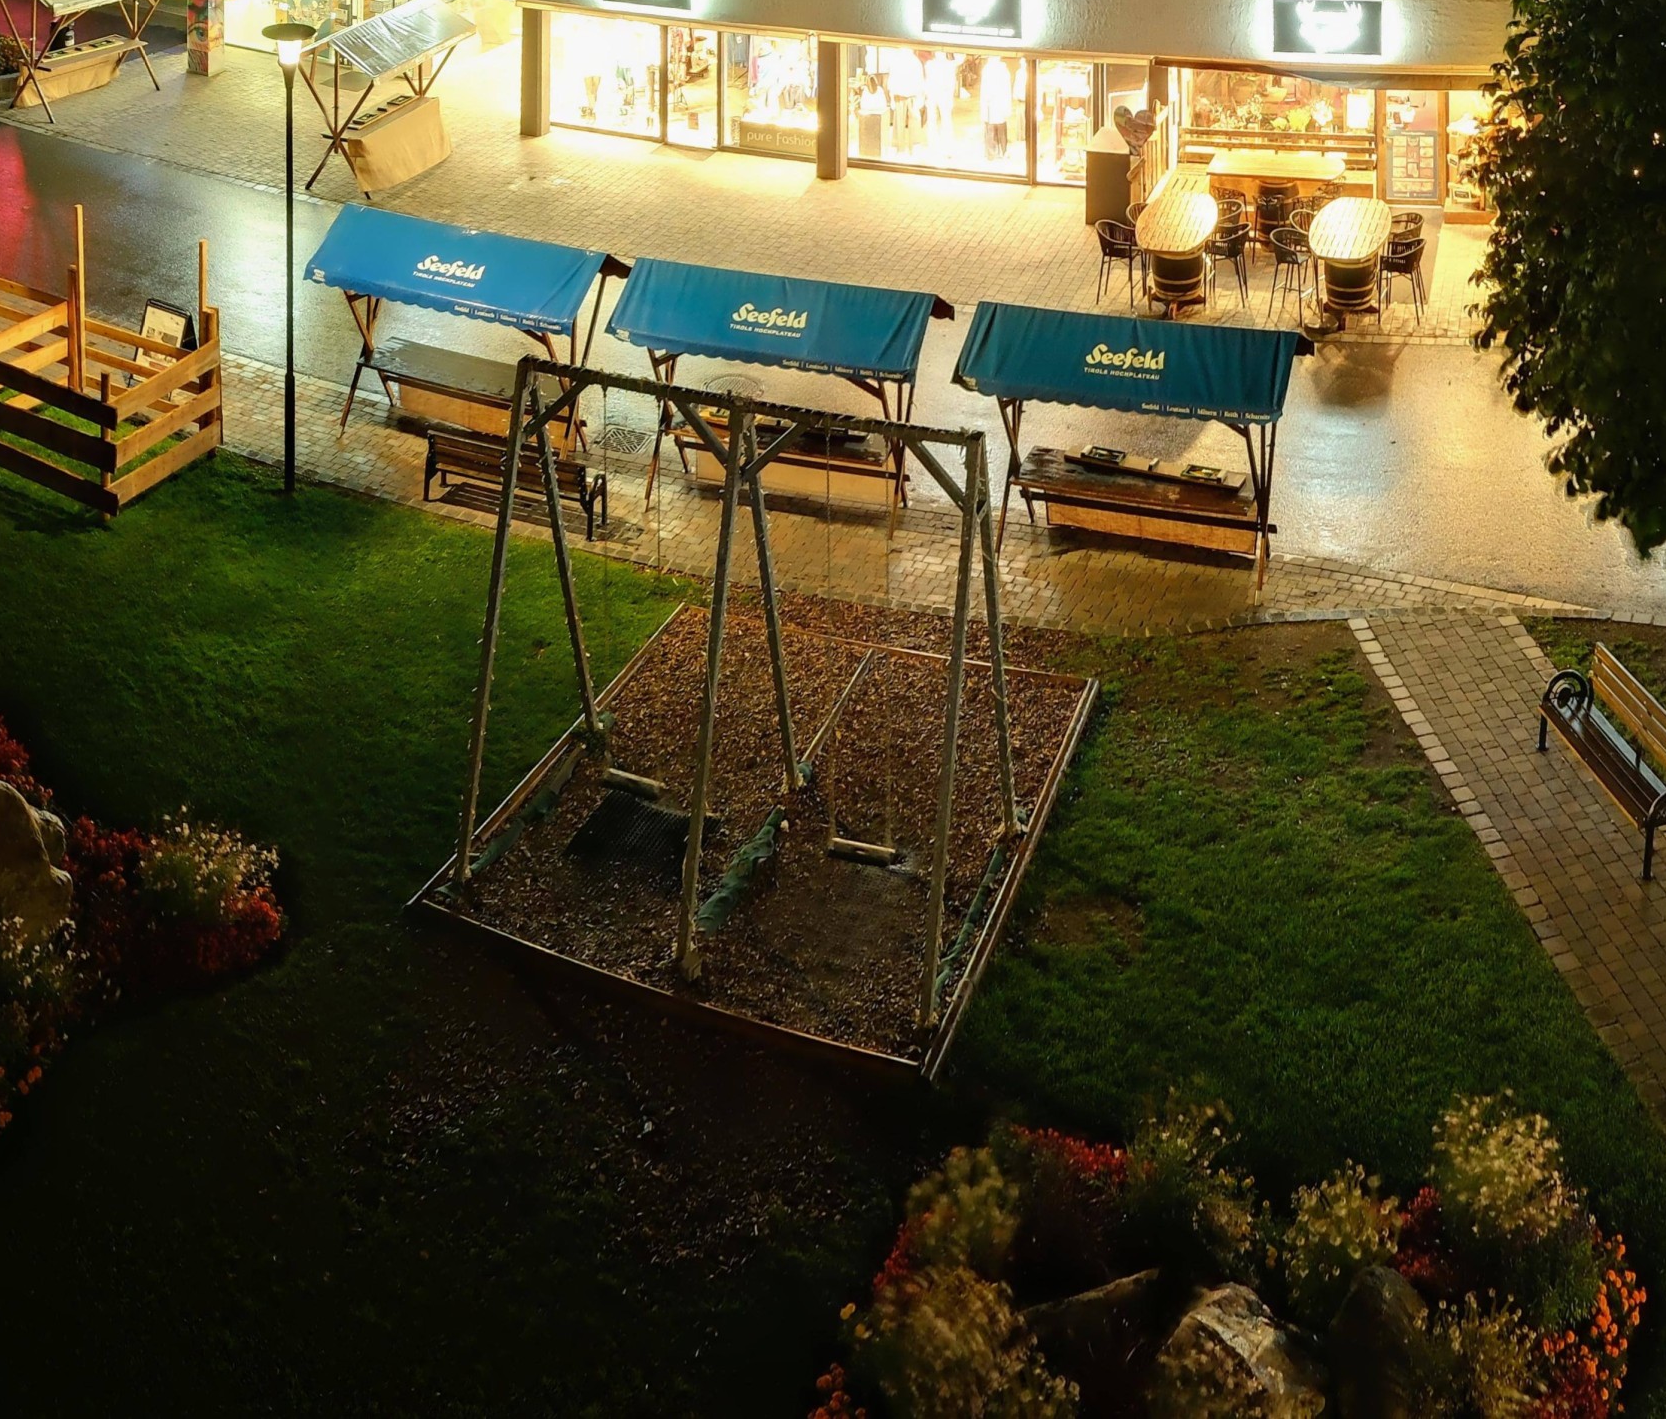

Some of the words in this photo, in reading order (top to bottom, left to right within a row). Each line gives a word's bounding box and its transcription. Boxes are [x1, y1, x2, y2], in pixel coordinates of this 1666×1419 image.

[416, 254, 486, 281] Seefeld
[731, 303, 808, 329] Seefeld
[1085, 343, 1165, 370] Seefeld
